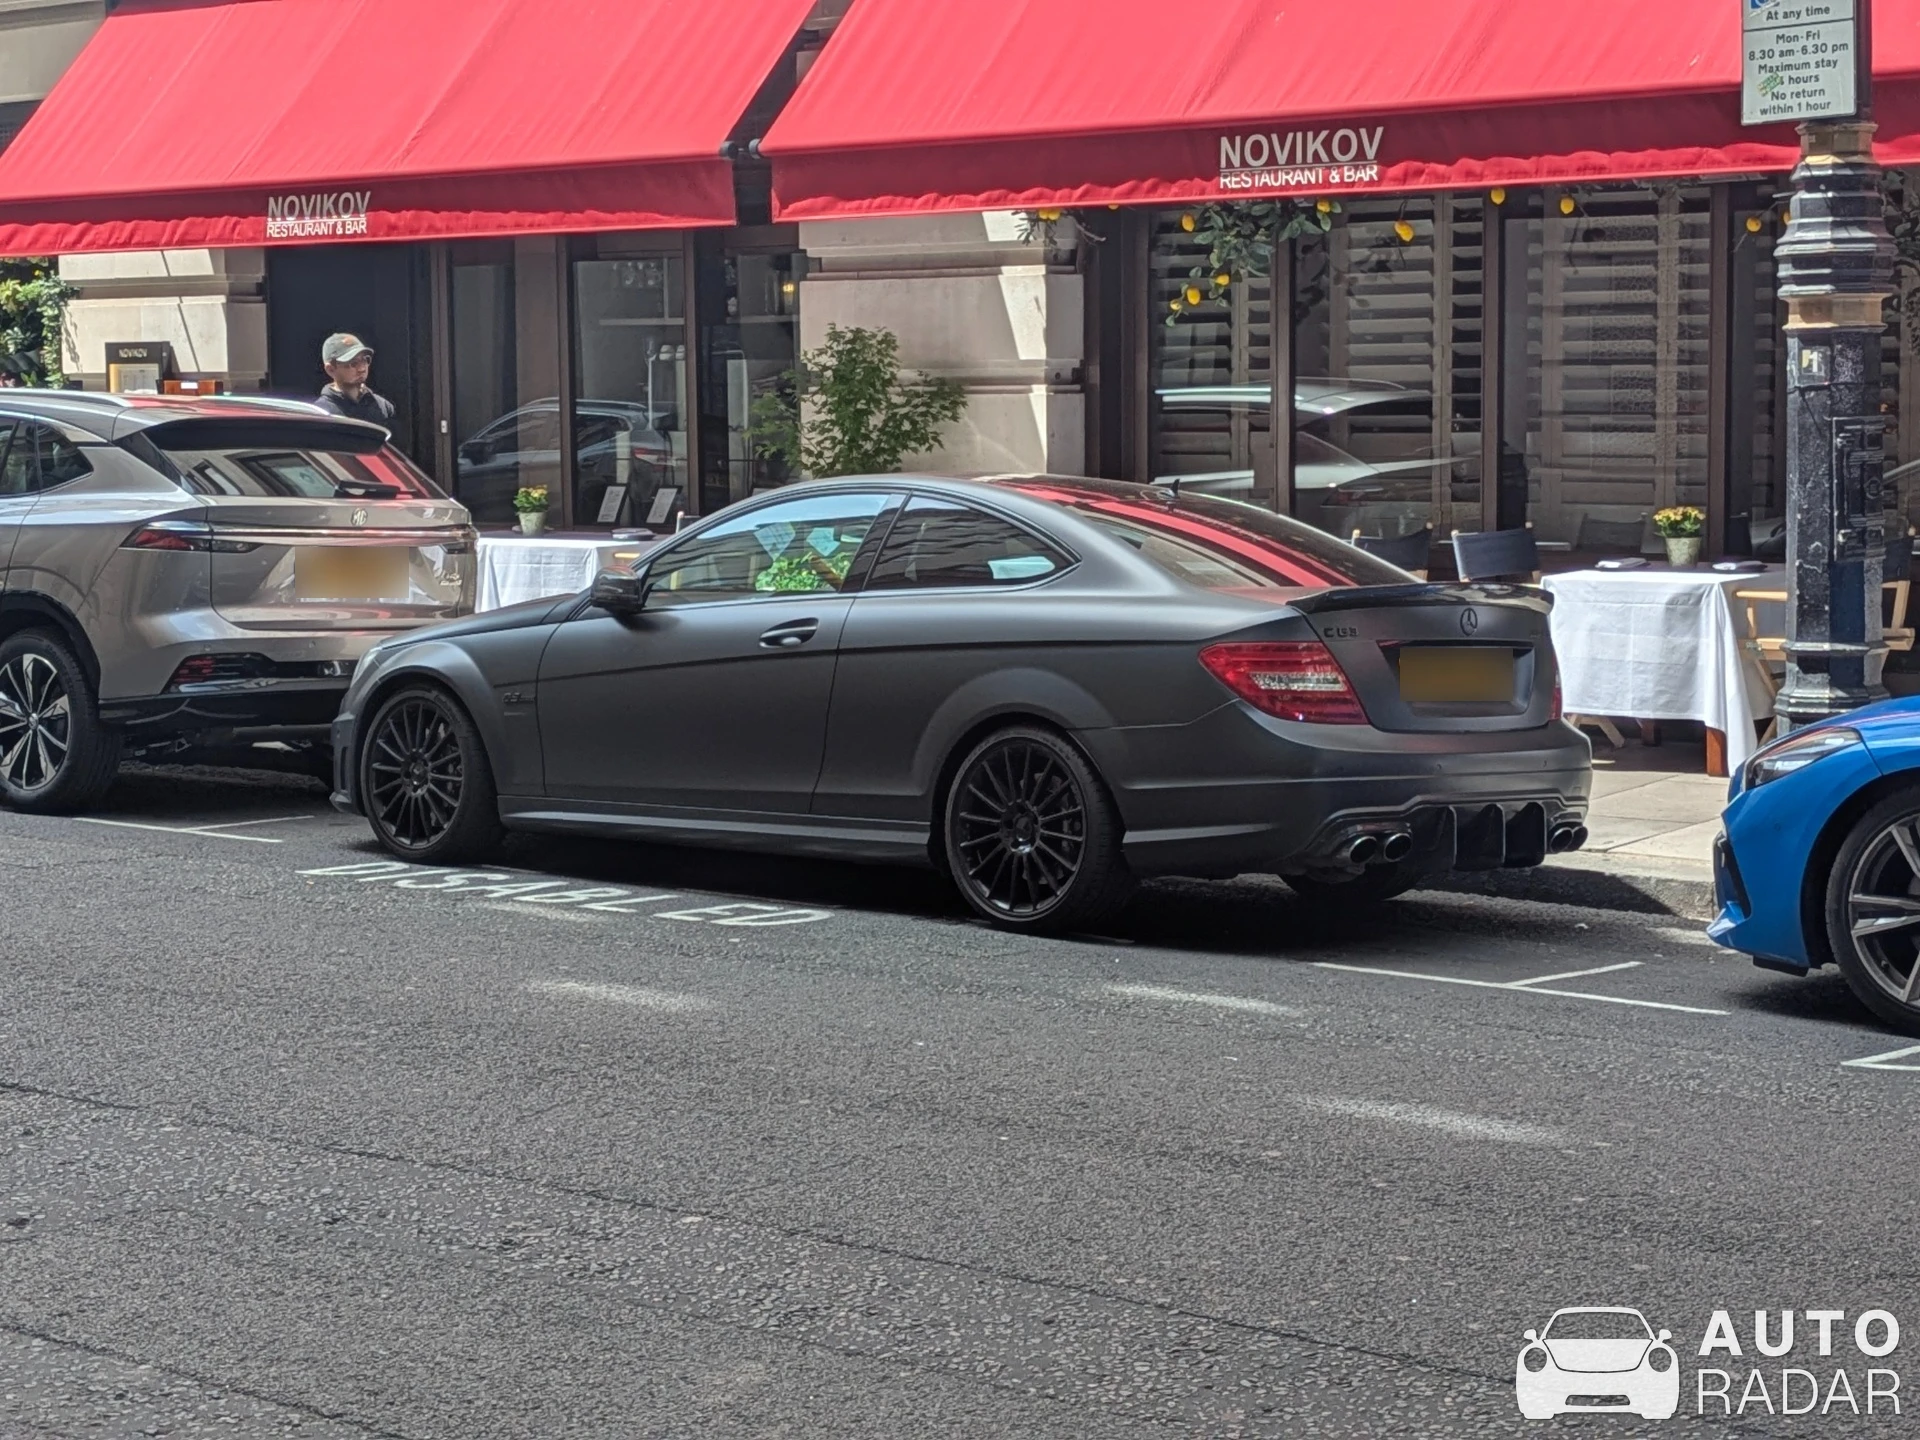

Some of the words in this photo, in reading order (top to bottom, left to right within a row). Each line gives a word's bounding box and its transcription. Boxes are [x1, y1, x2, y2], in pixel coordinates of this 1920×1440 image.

[1766, 10, 1779, 21] At
[1782, 9, 1802, 19] any
[1805, 6, 1830, 17] time
[1748, 49, 1775, 61] 8.30
[1831, 43, 1849, 54] pm
[1758, 60, 1811, 74] Maximum
[1814, 58, 1838, 69] stay
[1788, 74, 1820, 85] hours
[1771, 91, 1787, 101] No
[1790, 88, 1825, 99] return
[1759, 104, 1794, 116] within
[1806, 101, 1831, 111] hour
[1220, 126, 1384, 169] NOVIKOV
[1220, 167, 1325, 189] RESTAURANT
[1329, 164, 1340, 184] &
[1343, 164, 1378, 183] BAR
[267, 191, 371, 221] NOVIKOV
[266, 221, 335, 238] RESTAURANT
[335, 220, 344, 235] &
[345, 219, 367, 235] BAR
[295, 861, 836, 926] DISABLED
